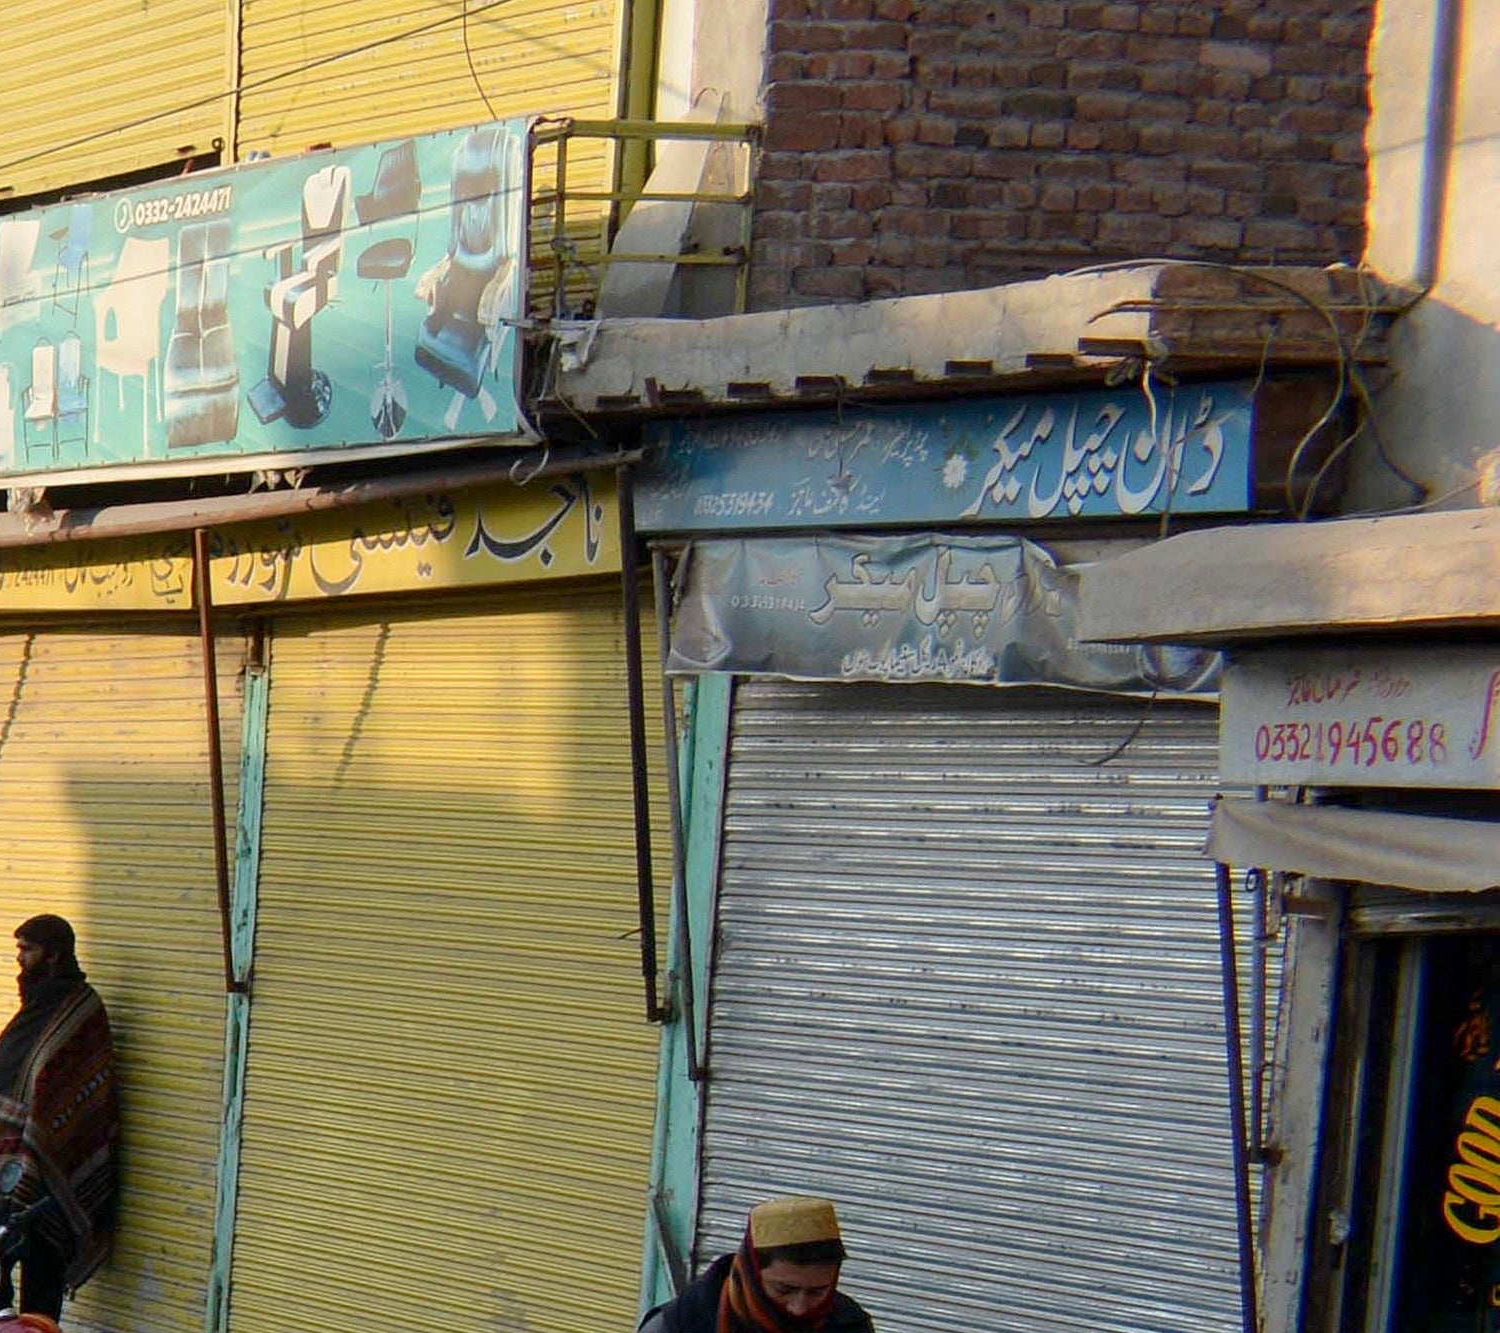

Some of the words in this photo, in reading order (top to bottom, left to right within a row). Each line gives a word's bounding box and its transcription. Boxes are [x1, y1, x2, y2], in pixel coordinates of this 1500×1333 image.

[135, 186, 232, 226] 0332-2424471
[958, 402, 1055, 521] میکر
[1027, 400, 1127, 519] چپل
[1254, 716, 1450, 768] 03321945688
